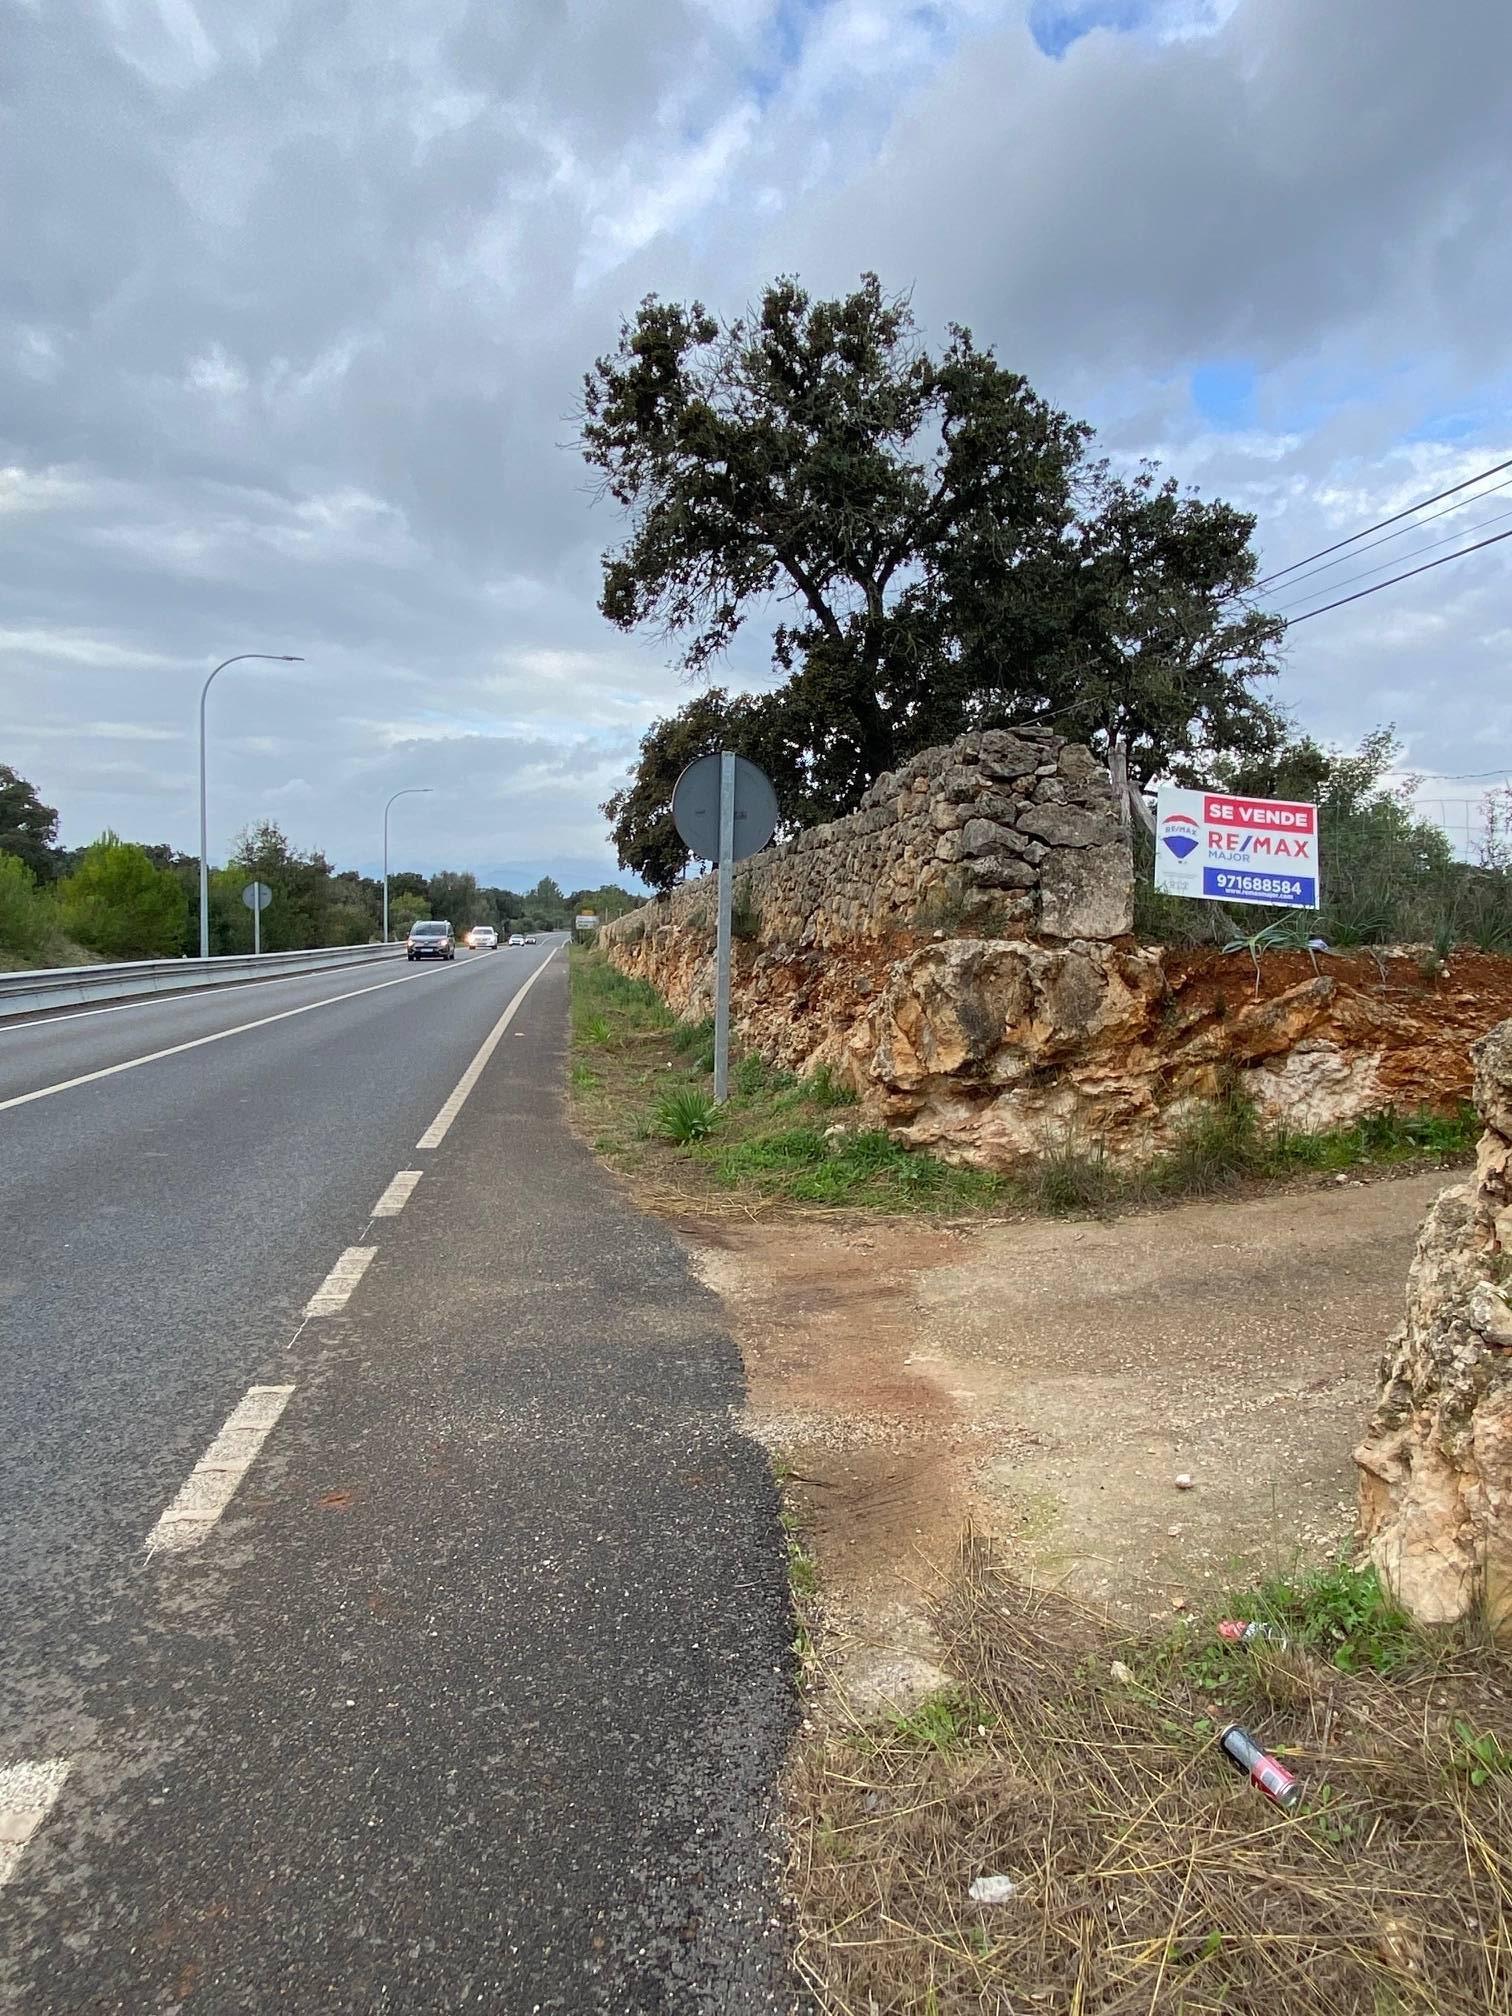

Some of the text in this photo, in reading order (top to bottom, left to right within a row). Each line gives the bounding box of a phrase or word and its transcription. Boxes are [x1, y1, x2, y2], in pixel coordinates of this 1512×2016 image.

[1209, 804, 1308, 827] SE VENDE
[1165, 826, 1198, 836] RE/MAX
[1208, 831, 1310, 859] RE/MAX
[1208, 850, 1250, 863] MAJOR
[1216, 873, 1302, 896] 971688584
